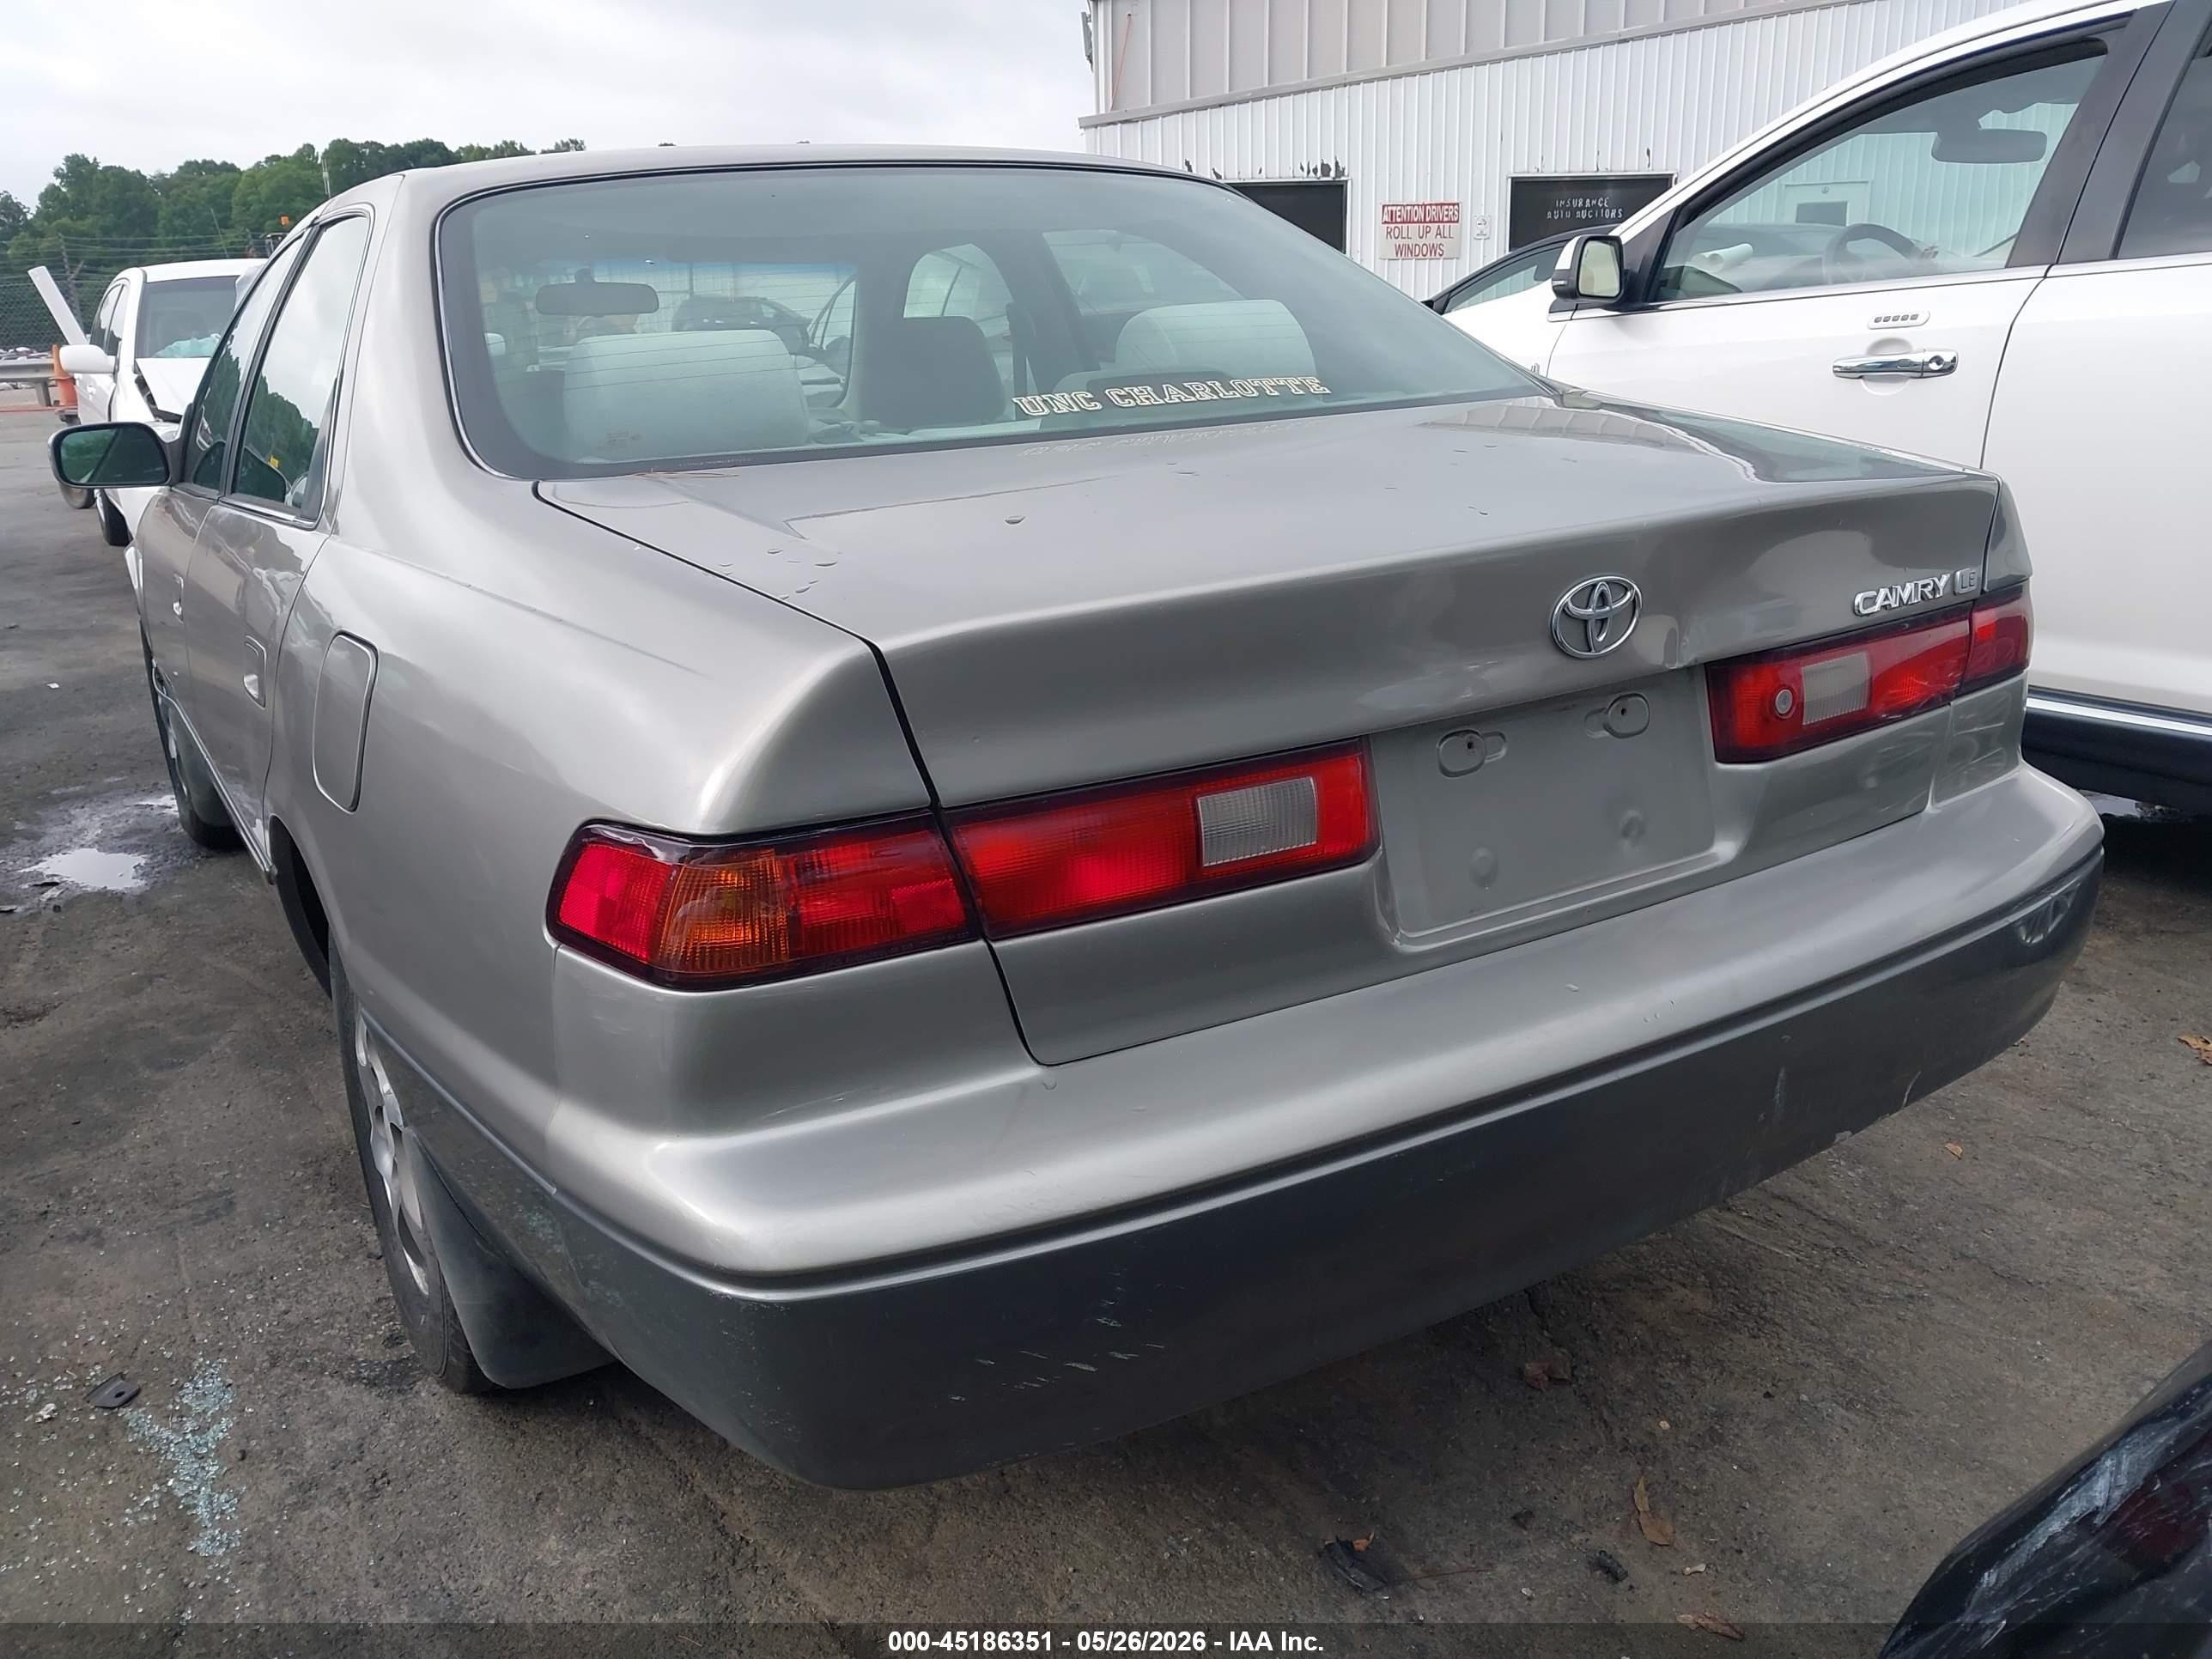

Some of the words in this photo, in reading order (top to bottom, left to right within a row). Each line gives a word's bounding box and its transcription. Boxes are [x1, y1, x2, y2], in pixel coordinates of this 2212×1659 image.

[1555, 197, 1609, 208] INSURANCE
[1382, 204, 1425, 223] ATTENTION
[1425, 204, 1459, 222] DRIVERS
[1385, 226, 1413, 240] ROLL
[1418, 225, 1431, 240] UP
[1435, 225, 1454, 239] ALL
[1395, 243, 1444, 257] WINDOWS
[1012, 391, 1103, 416] UNC
[1104, 376, 1332, 407] CHARLOTTE
[1854, 573, 1951, 616] CAMRY
[1958, 568, 1978, 592] LE
